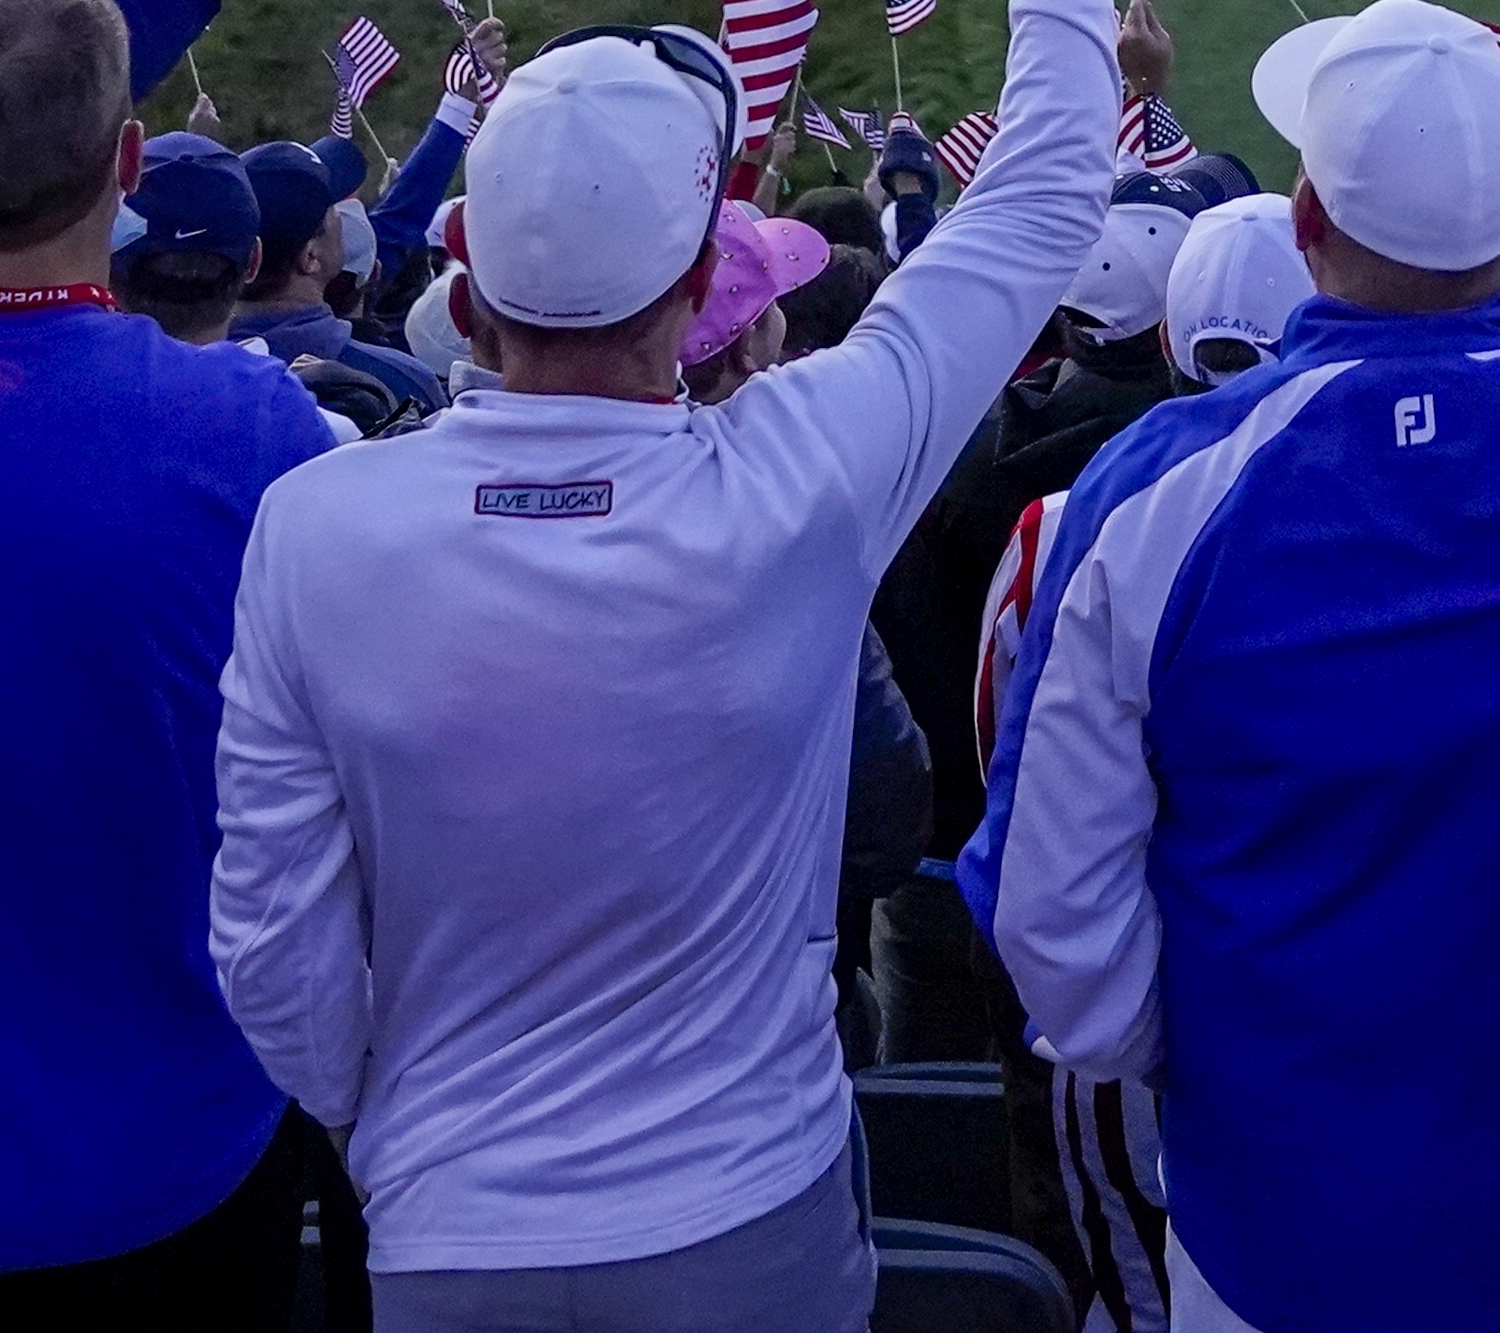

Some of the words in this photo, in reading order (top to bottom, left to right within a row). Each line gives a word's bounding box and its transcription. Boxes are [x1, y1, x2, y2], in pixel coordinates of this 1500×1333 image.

[1200, 315, 1269, 339] LOCATIO
[1394, 393, 1436, 448] FJ
[482, 490, 530, 510] LIVE
[539, 487, 608, 512] LUCKY
